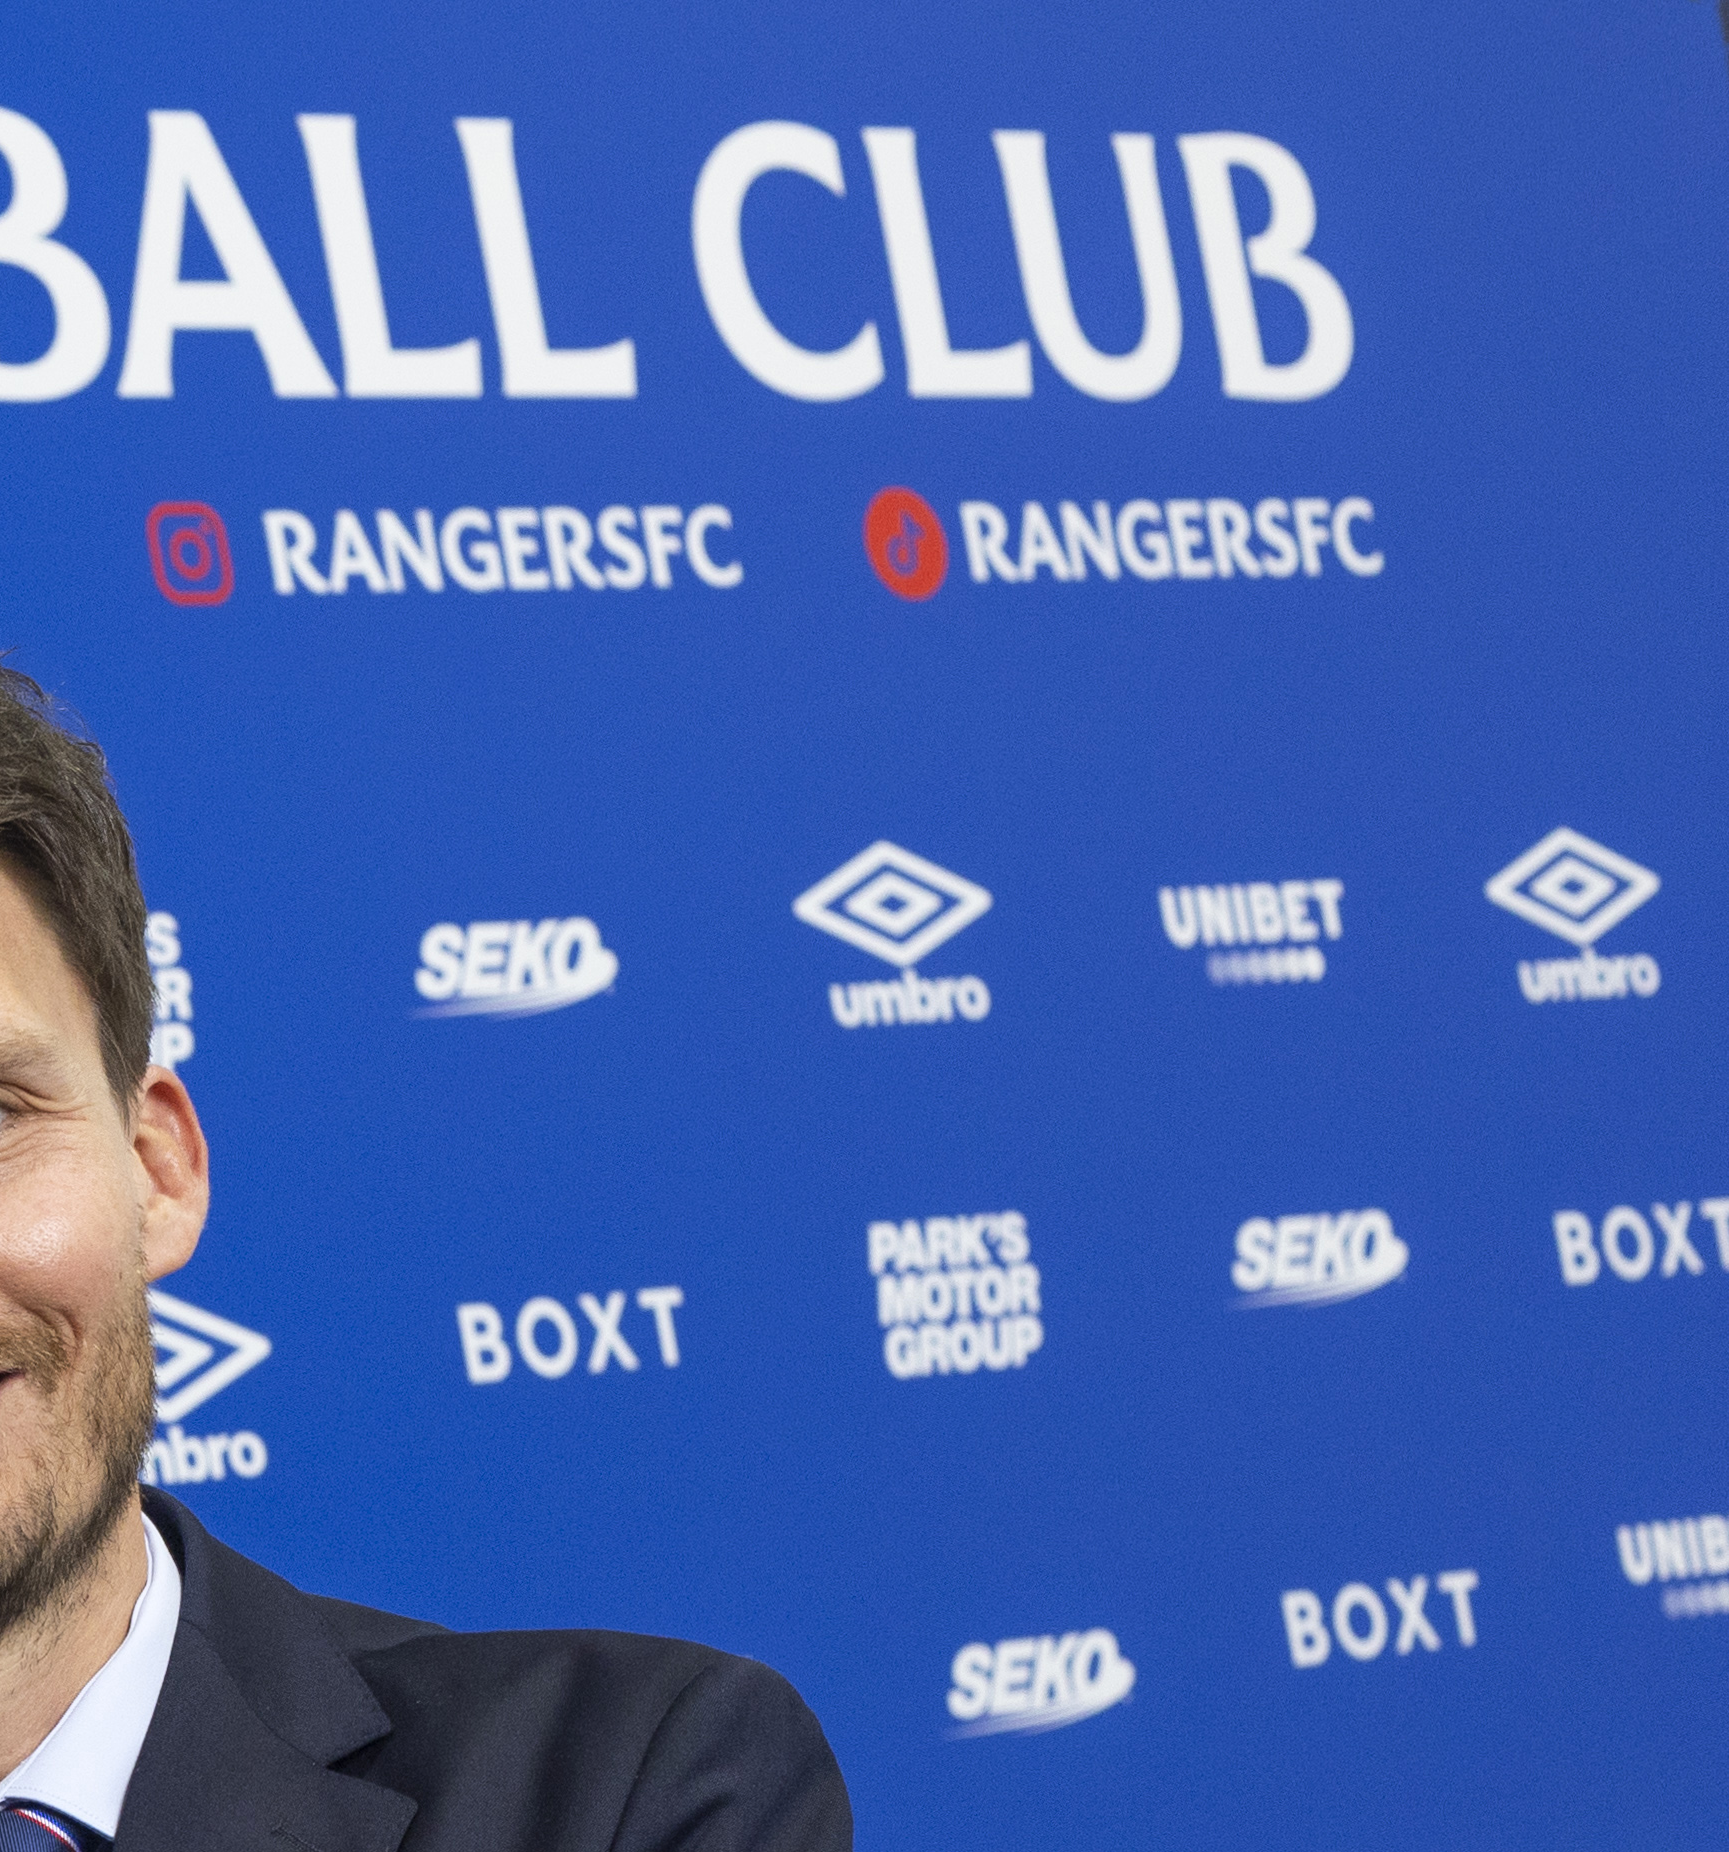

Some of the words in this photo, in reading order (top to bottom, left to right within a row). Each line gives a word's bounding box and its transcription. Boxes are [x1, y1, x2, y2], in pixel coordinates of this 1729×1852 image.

[692, 121, 1353, 401] CLUB
[261, 503, 743, 595] RANGERSFC
[959, 497, 1384, 582] RANGERSFC
[1159, 879, 1344, 948] UNIBET
[415, 917, 619, 1004] SEKO
[829, 965, 991, 1028] umbro
[1518, 945, 1661, 1003] umbro
[1232, 1208, 1409, 1294] SEKO
[457, 1286, 684, 1384] BOXT
[877, 1262, 1041, 1329] MOTOR
[884, 1315, 1043, 1380] GROUP
[1616, 1514, 1729, 1586] UNIB
[1281, 1570, 1479, 1668] BOXT
[947, 1628, 1136, 1722] SEKO
